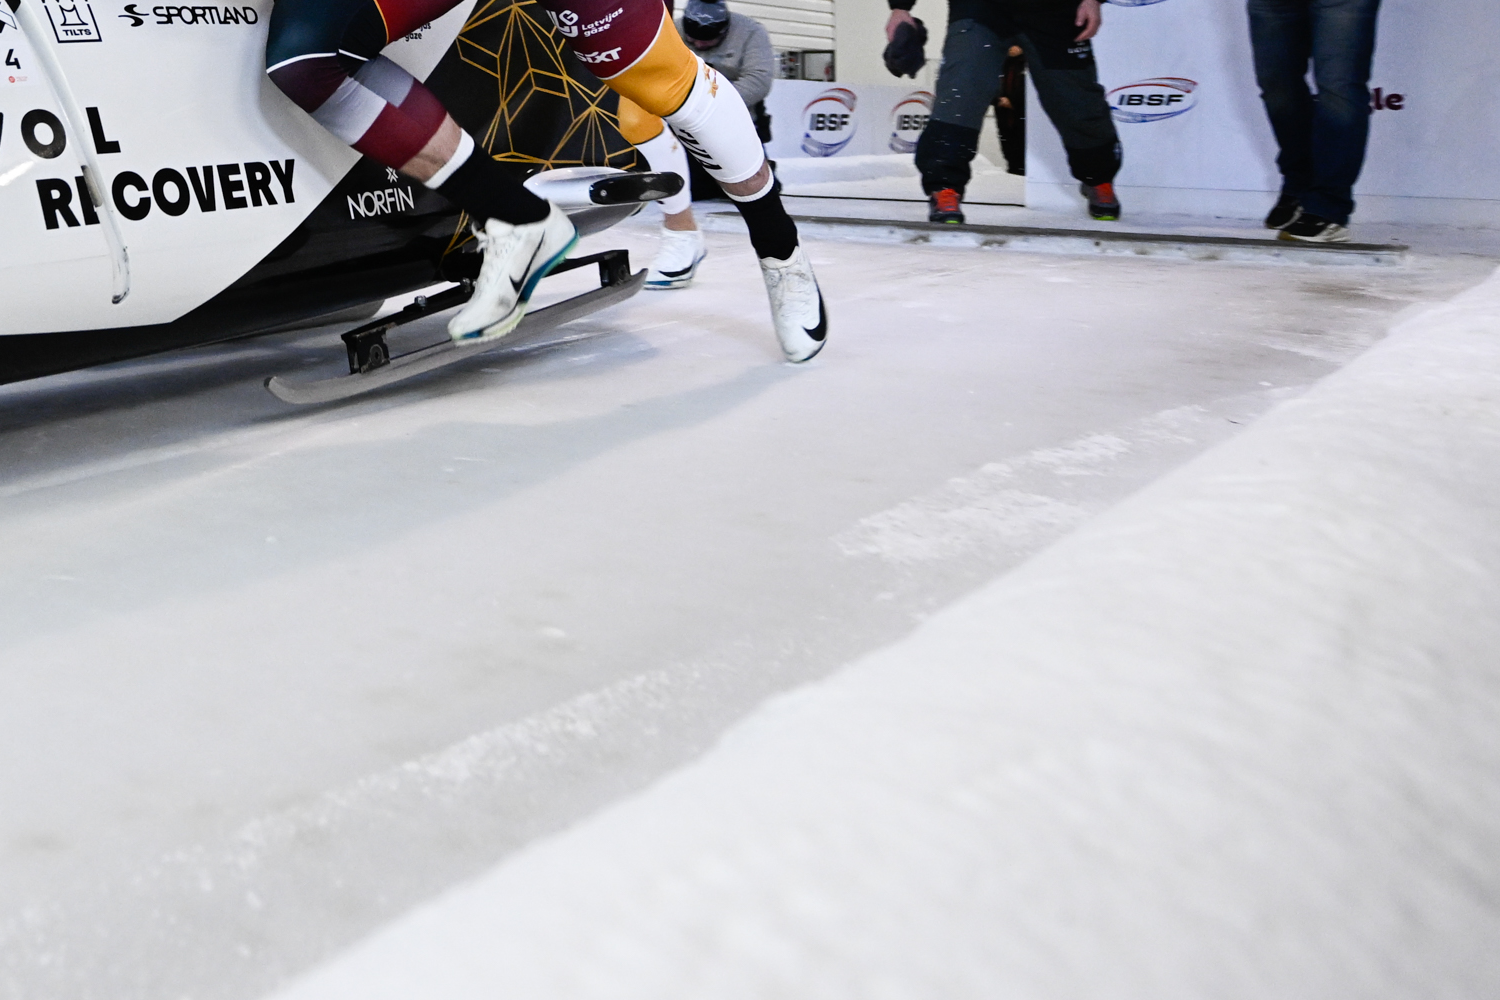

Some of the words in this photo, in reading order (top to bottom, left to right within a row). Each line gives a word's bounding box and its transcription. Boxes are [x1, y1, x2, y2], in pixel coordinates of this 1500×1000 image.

[152, 5, 258, 25] SPORTLAND
[581, 7, 624, 31] Latvijas
[62, 29, 92, 37] TILTS
[584, 23, 611, 37] gāze
[5, 48, 21, 70] 4
[1118, 94, 1185, 106] IBSF
[810, 113, 851, 131] IBSF
[20, 106, 121, 159] OL
[346, 185, 415, 220] NORFIN
